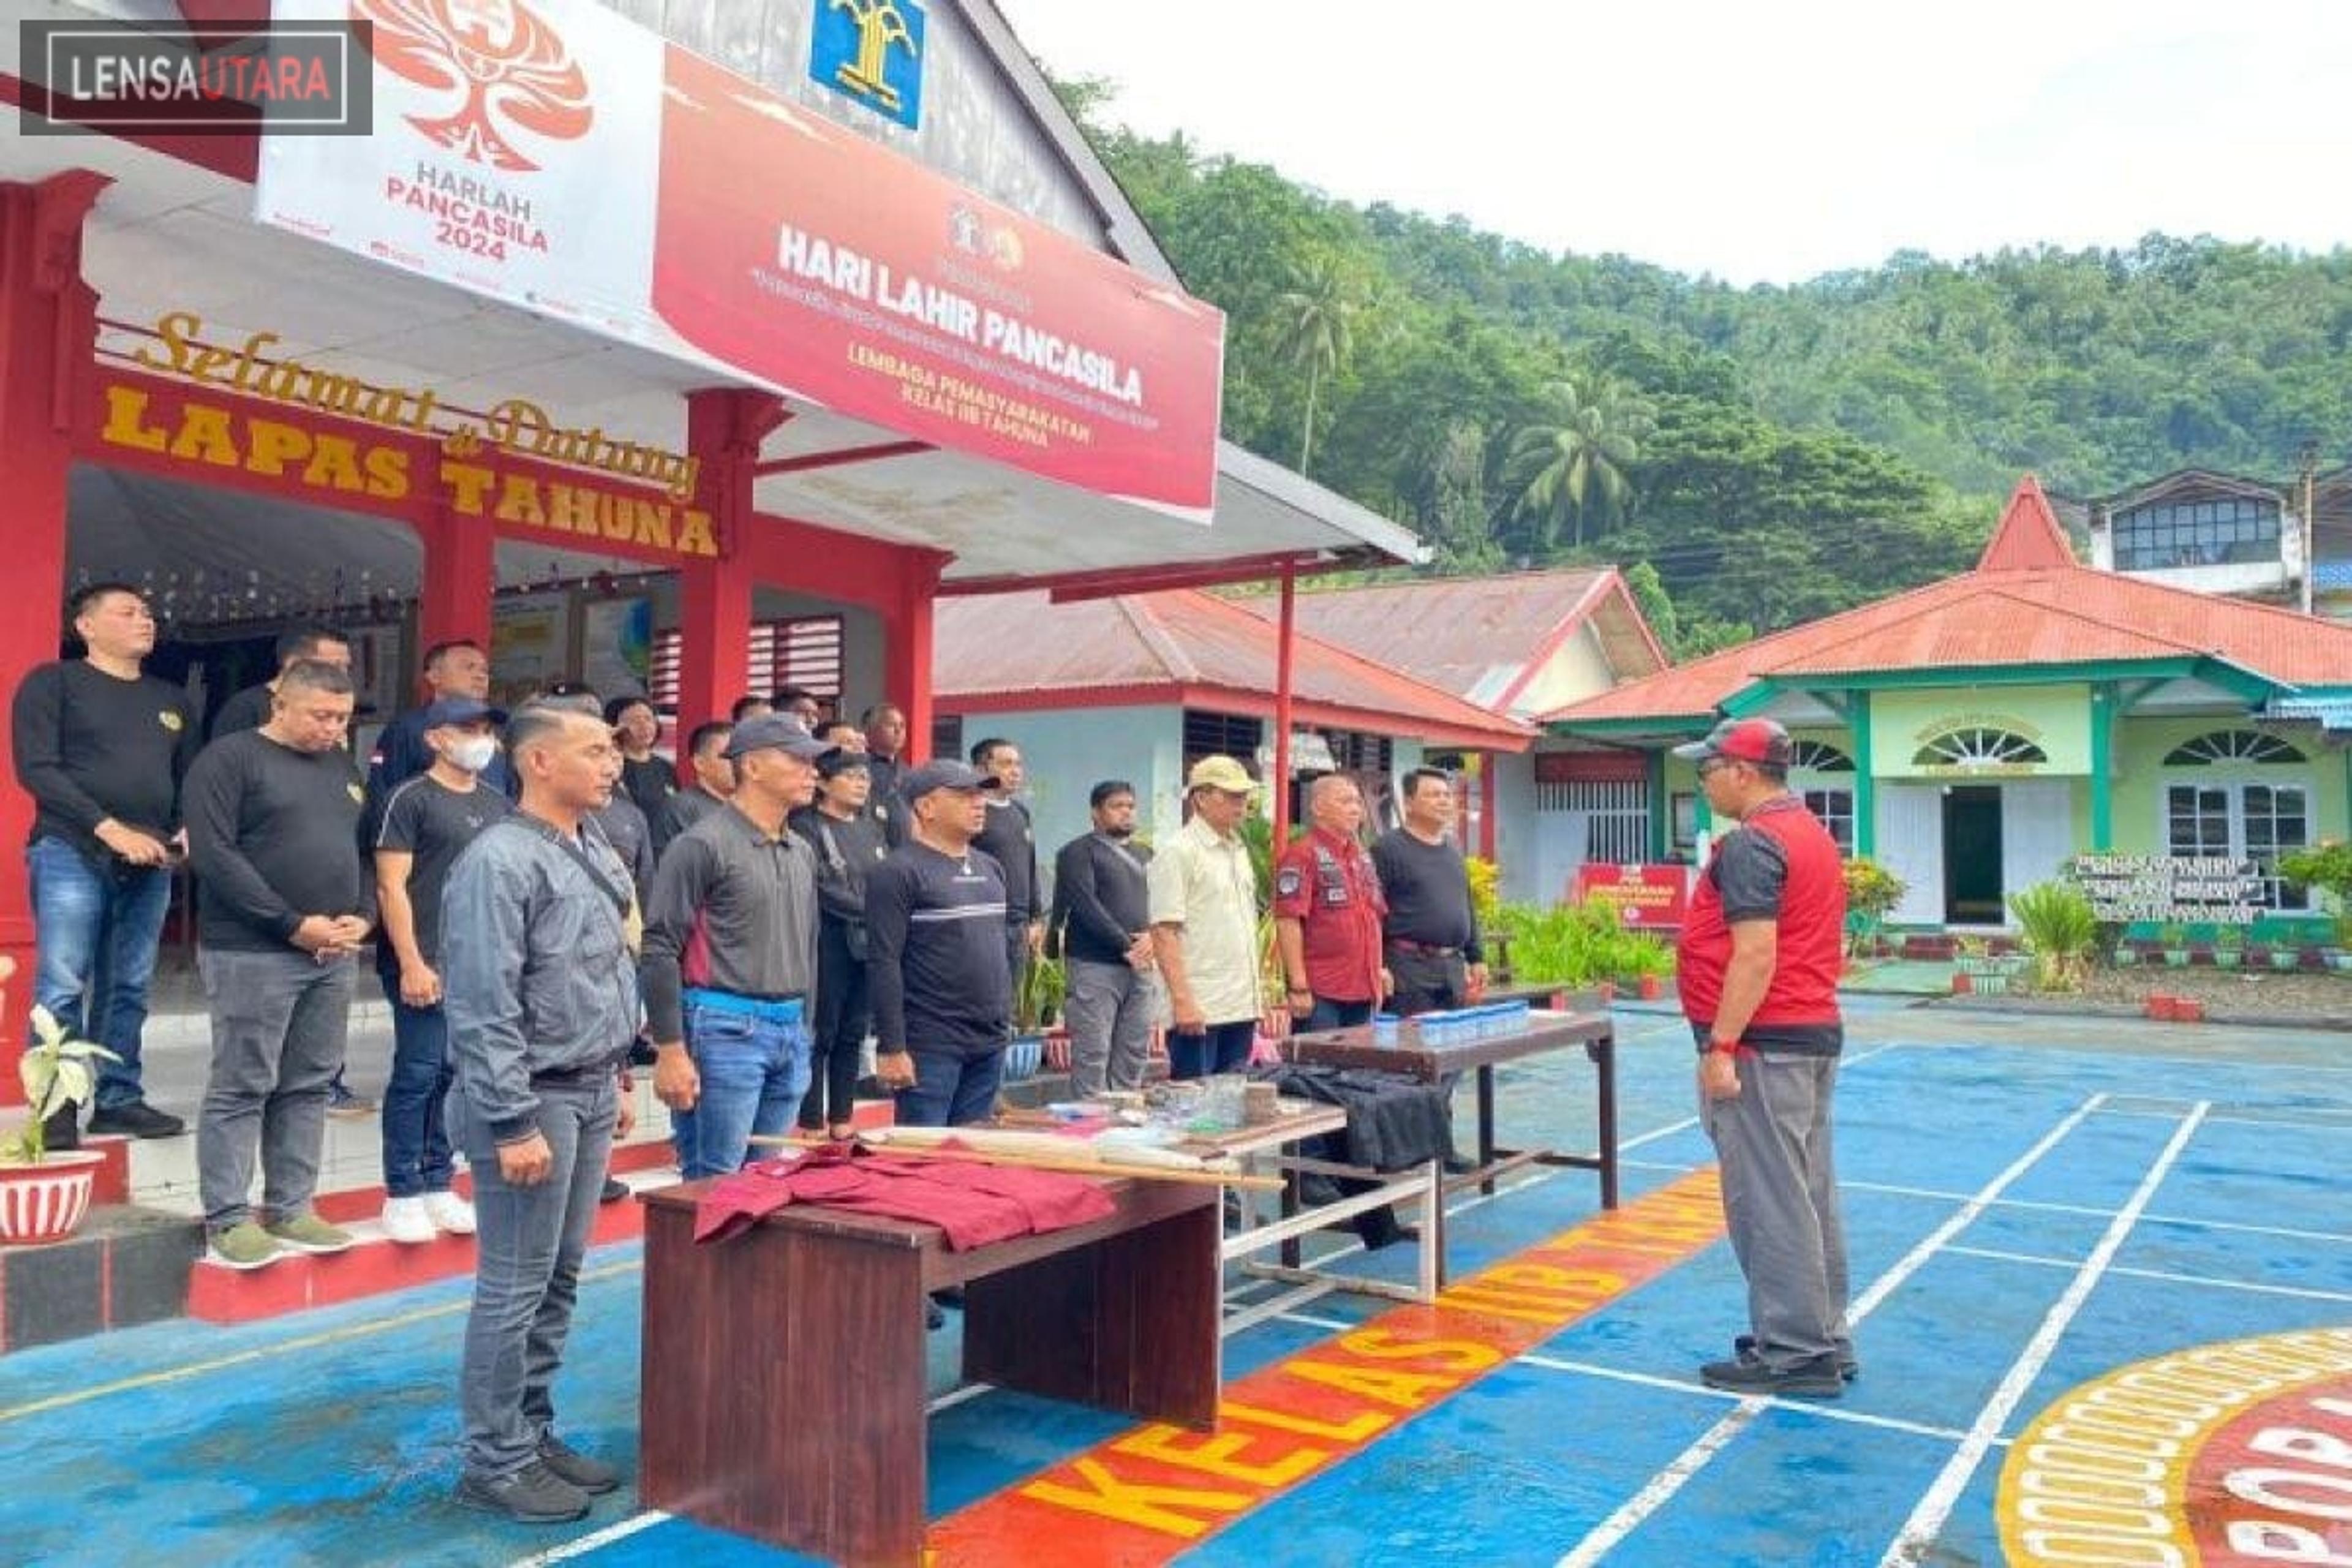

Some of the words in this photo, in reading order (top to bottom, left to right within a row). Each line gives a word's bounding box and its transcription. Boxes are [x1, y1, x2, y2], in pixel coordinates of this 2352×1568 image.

[386, 177, 548, 252] PANCASILA
[417, 160, 530, 222] HARLAH
[435, 221, 506, 262] 2024
[778, 221, 871, 300] HARI
[877, 264, 978, 343] LAHIR
[983, 307, 1144, 407] PANCASILA
[135, 311, 436, 429] Selamat
[488, 399, 699, 502] Datang
[847, 343, 936, 388] LEMBAGA
[940, 375, 1093, 444] PEMASYARAKATAN
[902, 382, 953, 417] KELAS
[982, 412, 1049, 448] TAHUNA
[102, 385, 409, 499] LAPAS
[441, 461, 718, 556] TAHUNA
[1019, 1326, 1501, 1540] KELAS
